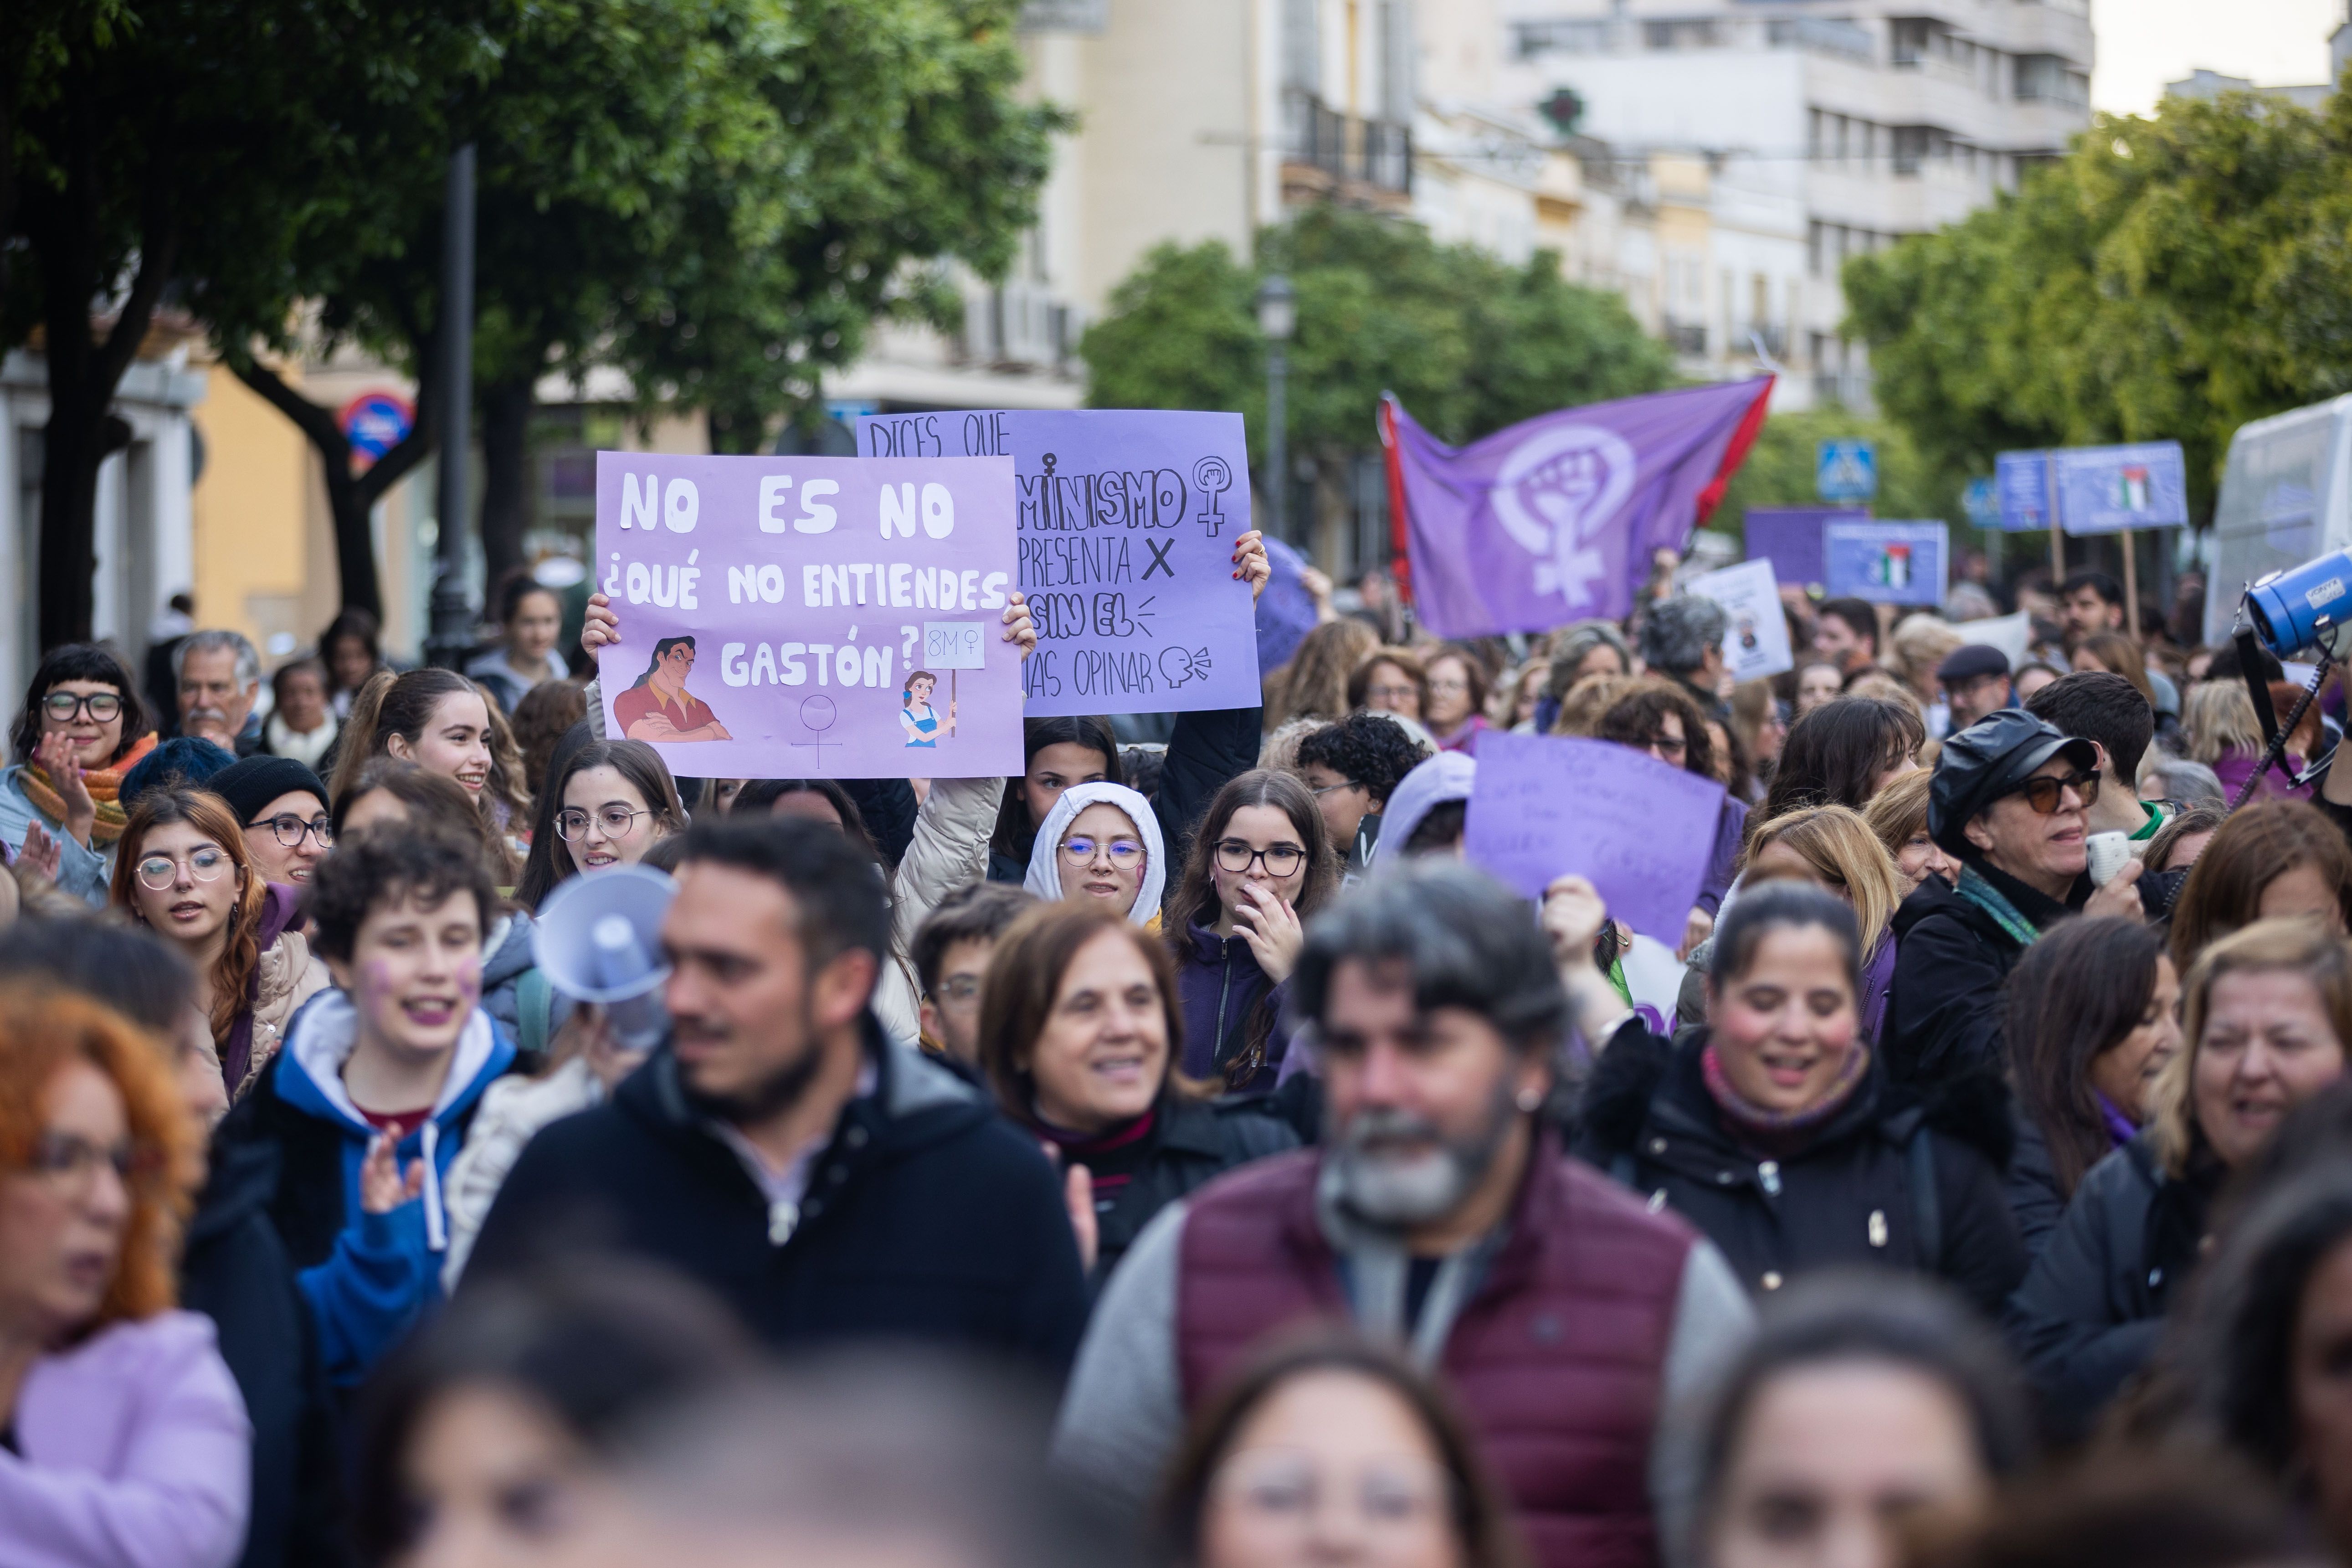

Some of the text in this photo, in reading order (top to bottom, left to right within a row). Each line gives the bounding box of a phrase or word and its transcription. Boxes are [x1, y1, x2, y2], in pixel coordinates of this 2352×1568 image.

[870, 412, 1010, 458] DICES QUE
[620, 472, 955, 540] NO ES NO
[603, 548, 1008, 611] ¿QUÉ NO ENTIENDES
[1019, 536, 1132, 587] PRESENTA
[1094, 592, 1135, 637] EL
[721, 624, 919, 689] GASTÓN?
[928, 630, 958, 657] 8M
[1074, 649, 1154, 696] OPINAR
